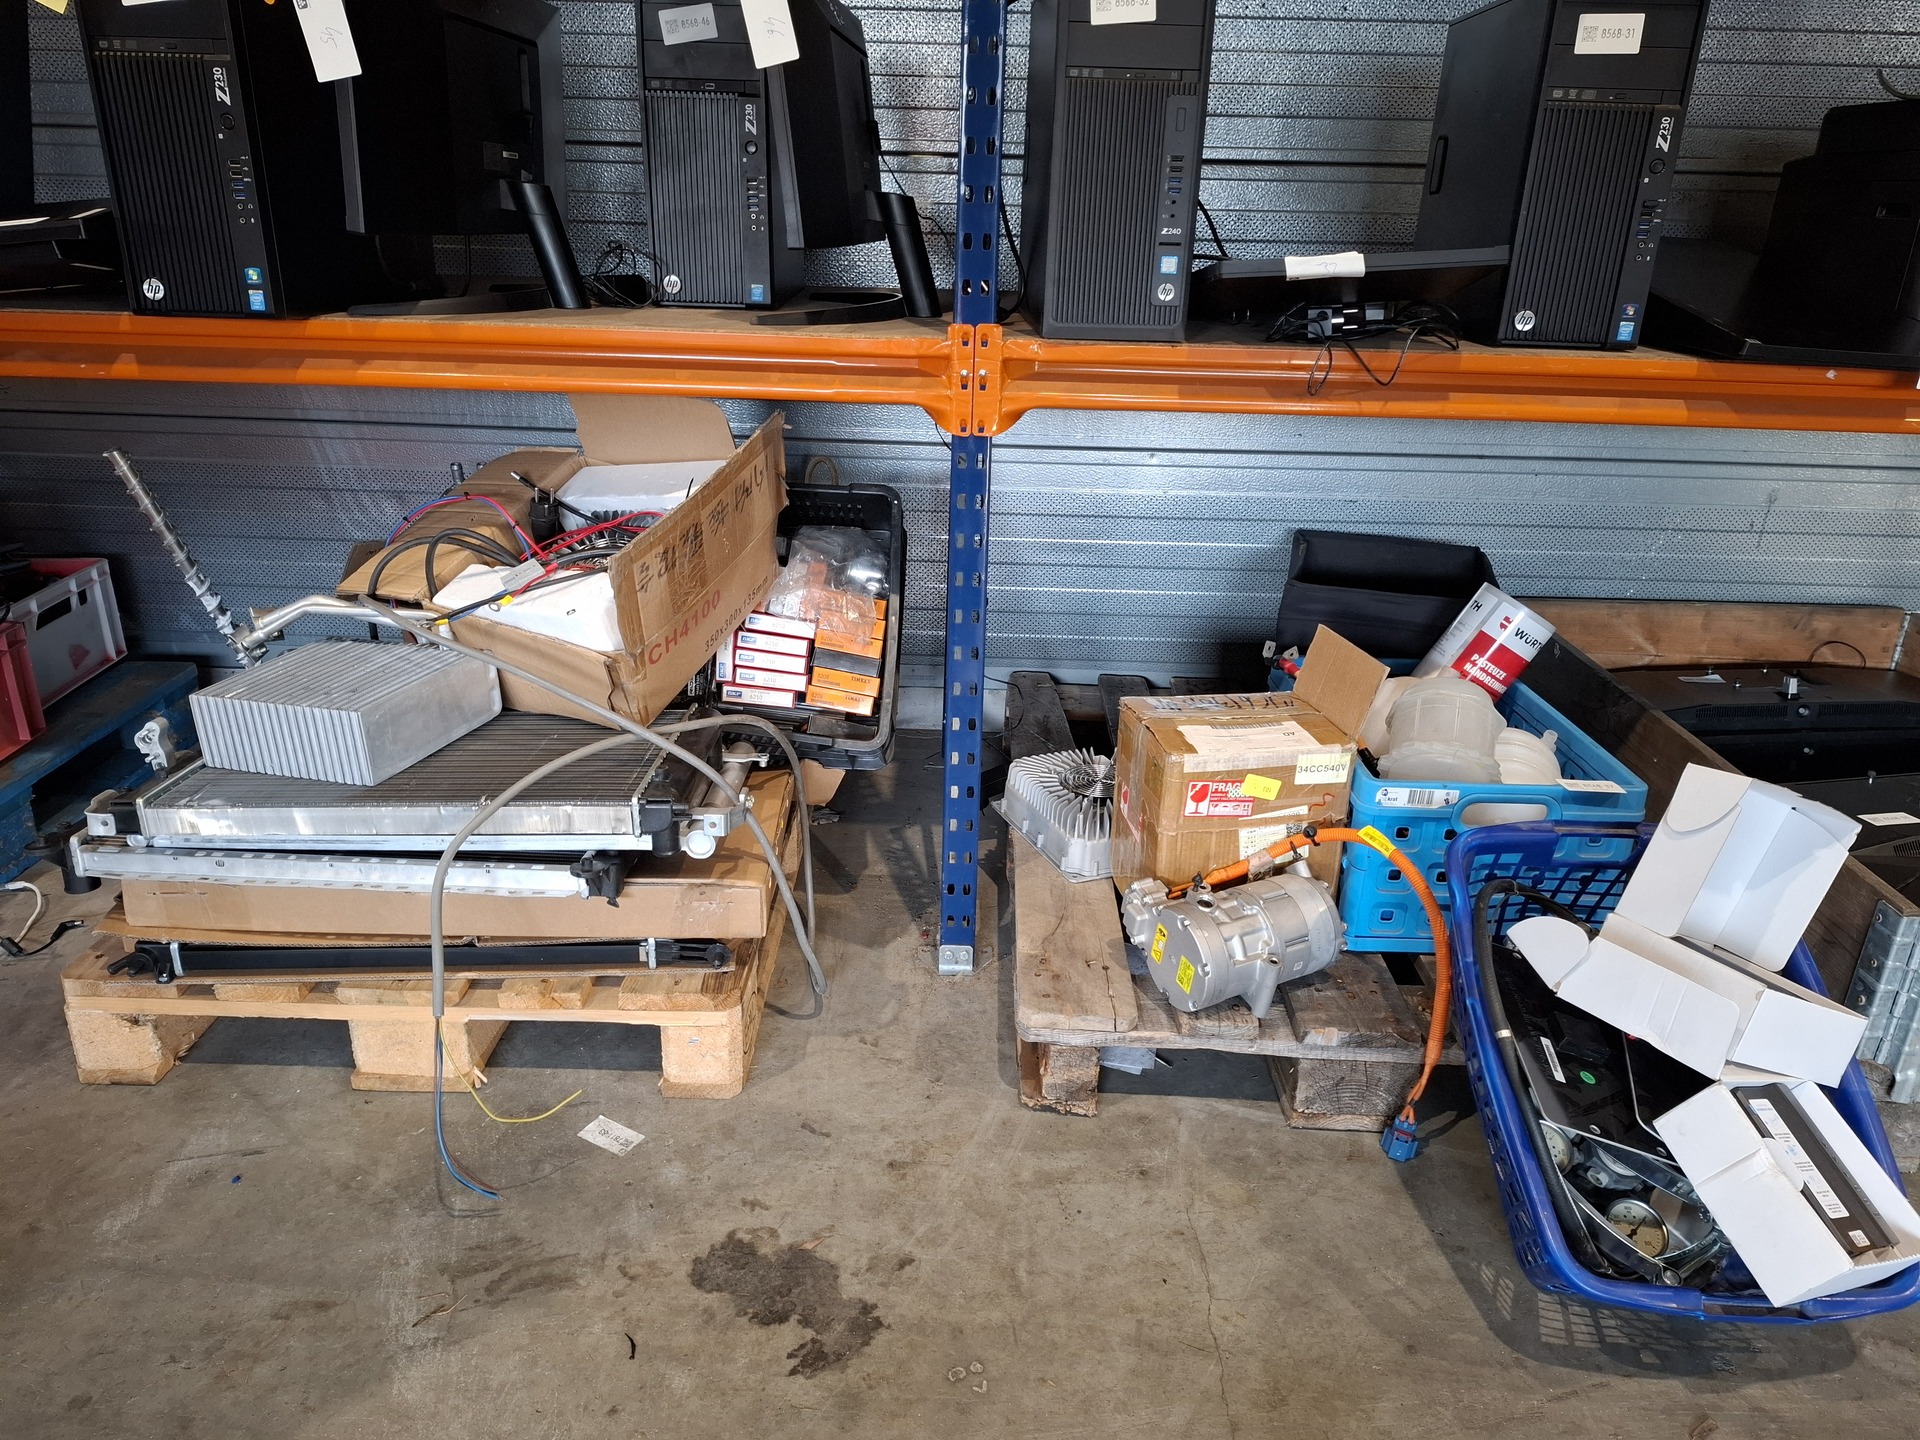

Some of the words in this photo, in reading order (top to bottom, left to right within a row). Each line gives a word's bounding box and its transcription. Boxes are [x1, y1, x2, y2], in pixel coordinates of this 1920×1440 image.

[680, 16, 711, 29] 8568-46
[1601, 28, 1636, 39] 8568-31
[212, 66, 231, 106] Z230
[745, 104, 757, 136] Z230
[1655, 116, 1671, 152] Z230
[145, 278, 162, 300] hp
[665, 275, 679, 294] hp
[1159, 283, 1174, 301] hp
[1517, 310, 1533, 331] hp
[647, 588, 721, 666] CH4100
[1470, 653, 1507, 681] PASTEUZE
[1297, 763, 1347, 774] 34CC540V
[1212, 782, 1244, 793] FRAG
